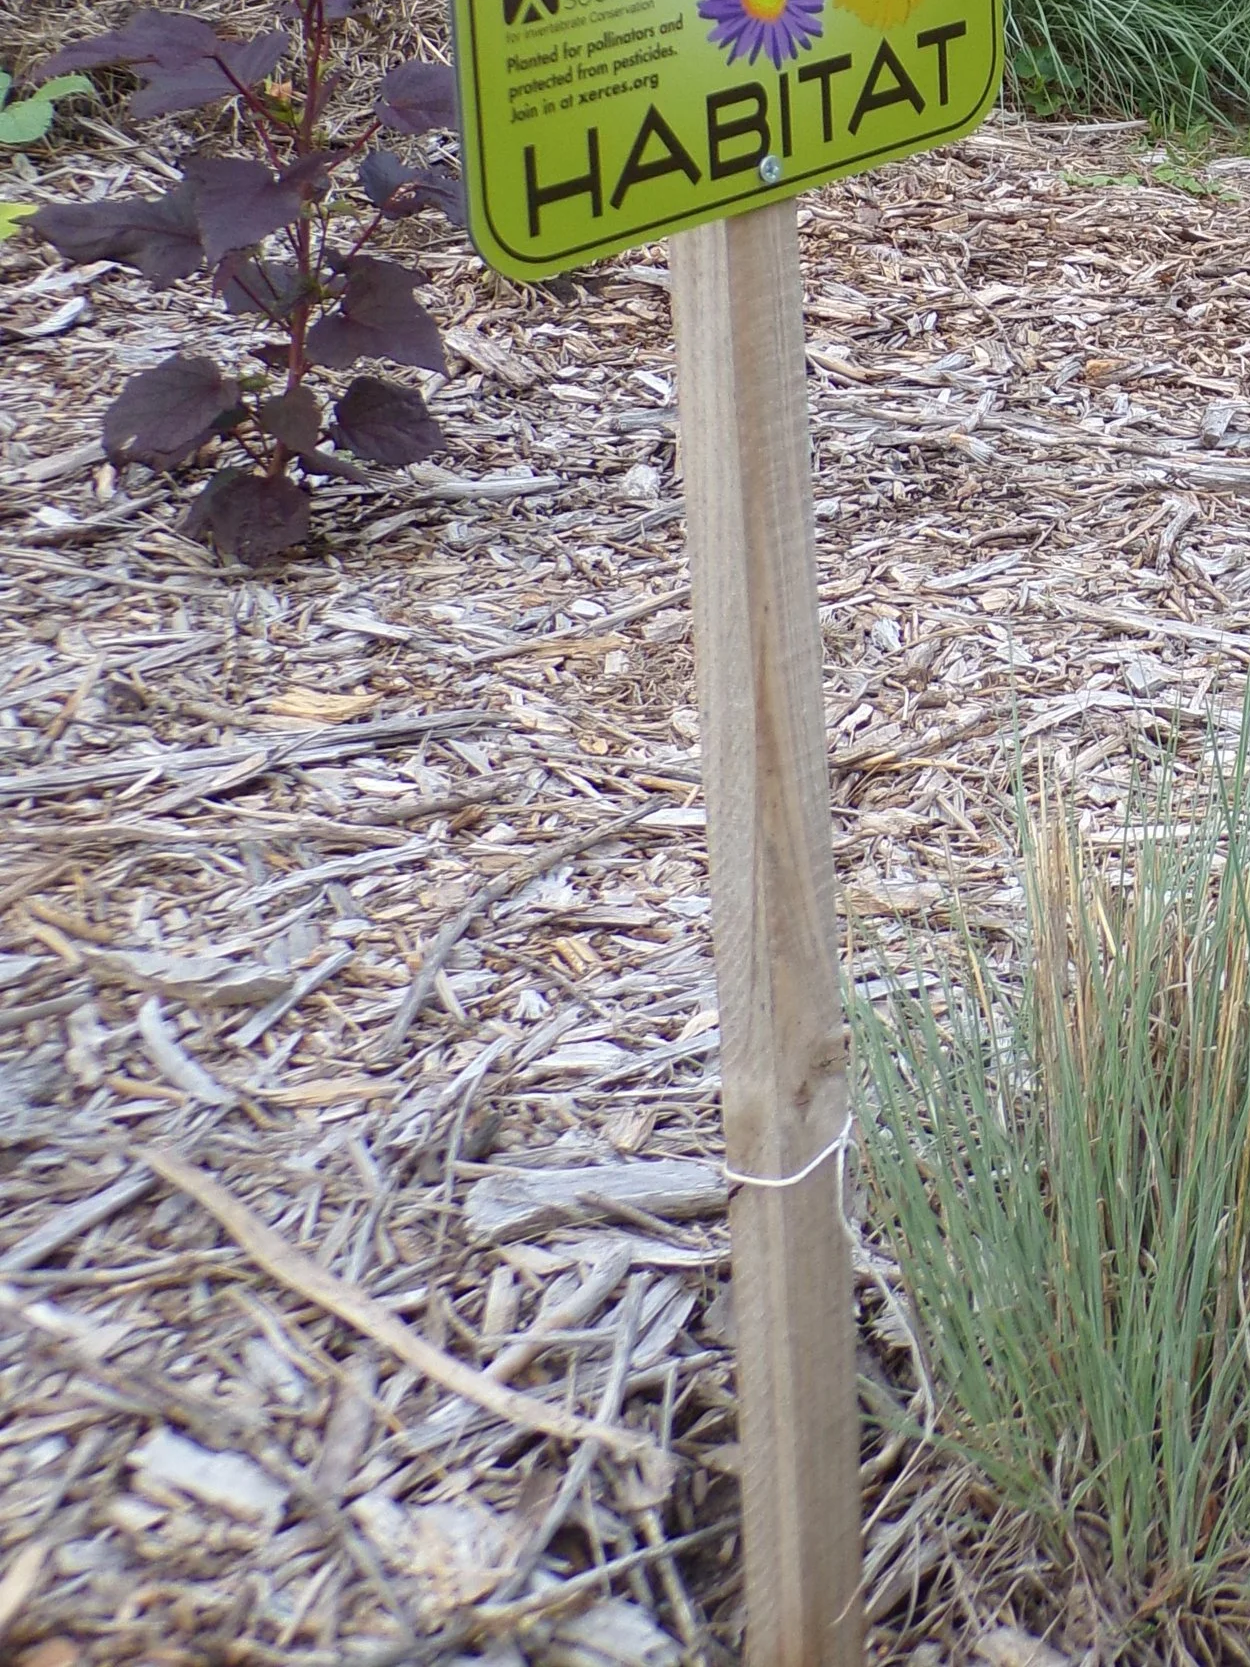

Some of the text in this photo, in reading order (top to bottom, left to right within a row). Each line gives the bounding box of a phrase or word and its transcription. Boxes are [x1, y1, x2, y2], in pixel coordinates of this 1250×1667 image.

[507, 12, 684, 74] Planted for pollinators and
[508, 42, 678, 102] protected from pesticides.
[511, 73, 659, 123] Join in at xerces.org
[524, 22, 967, 236] HABITAT
